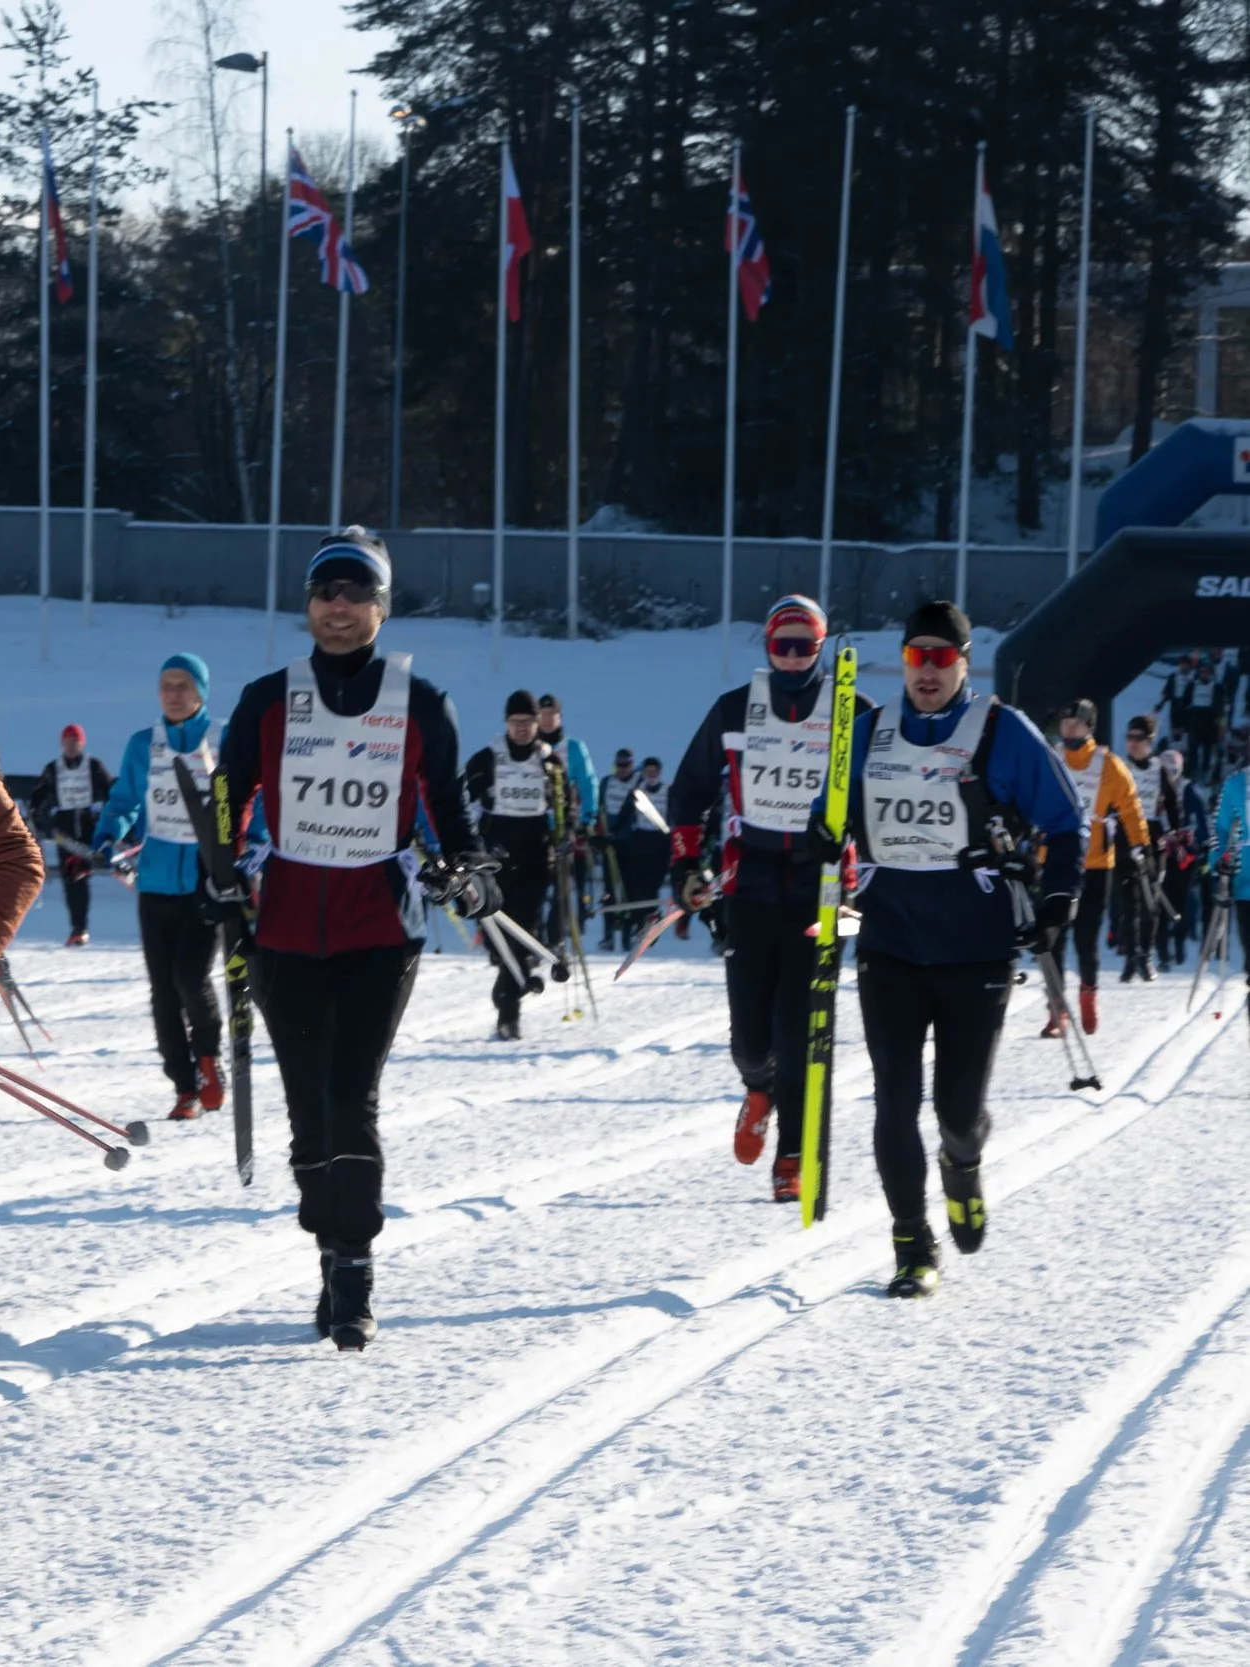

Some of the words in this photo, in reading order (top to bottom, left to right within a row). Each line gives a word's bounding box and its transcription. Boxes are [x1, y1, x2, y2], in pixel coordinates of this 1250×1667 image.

[362, 714, 407, 729] renta
[288, 736, 335, 748] VITAMIN
[750, 765, 821, 790] 7155
[292, 776, 389, 809] 7109
[874, 797, 955, 826] 7029
[296, 820, 381, 839] SALOMON
